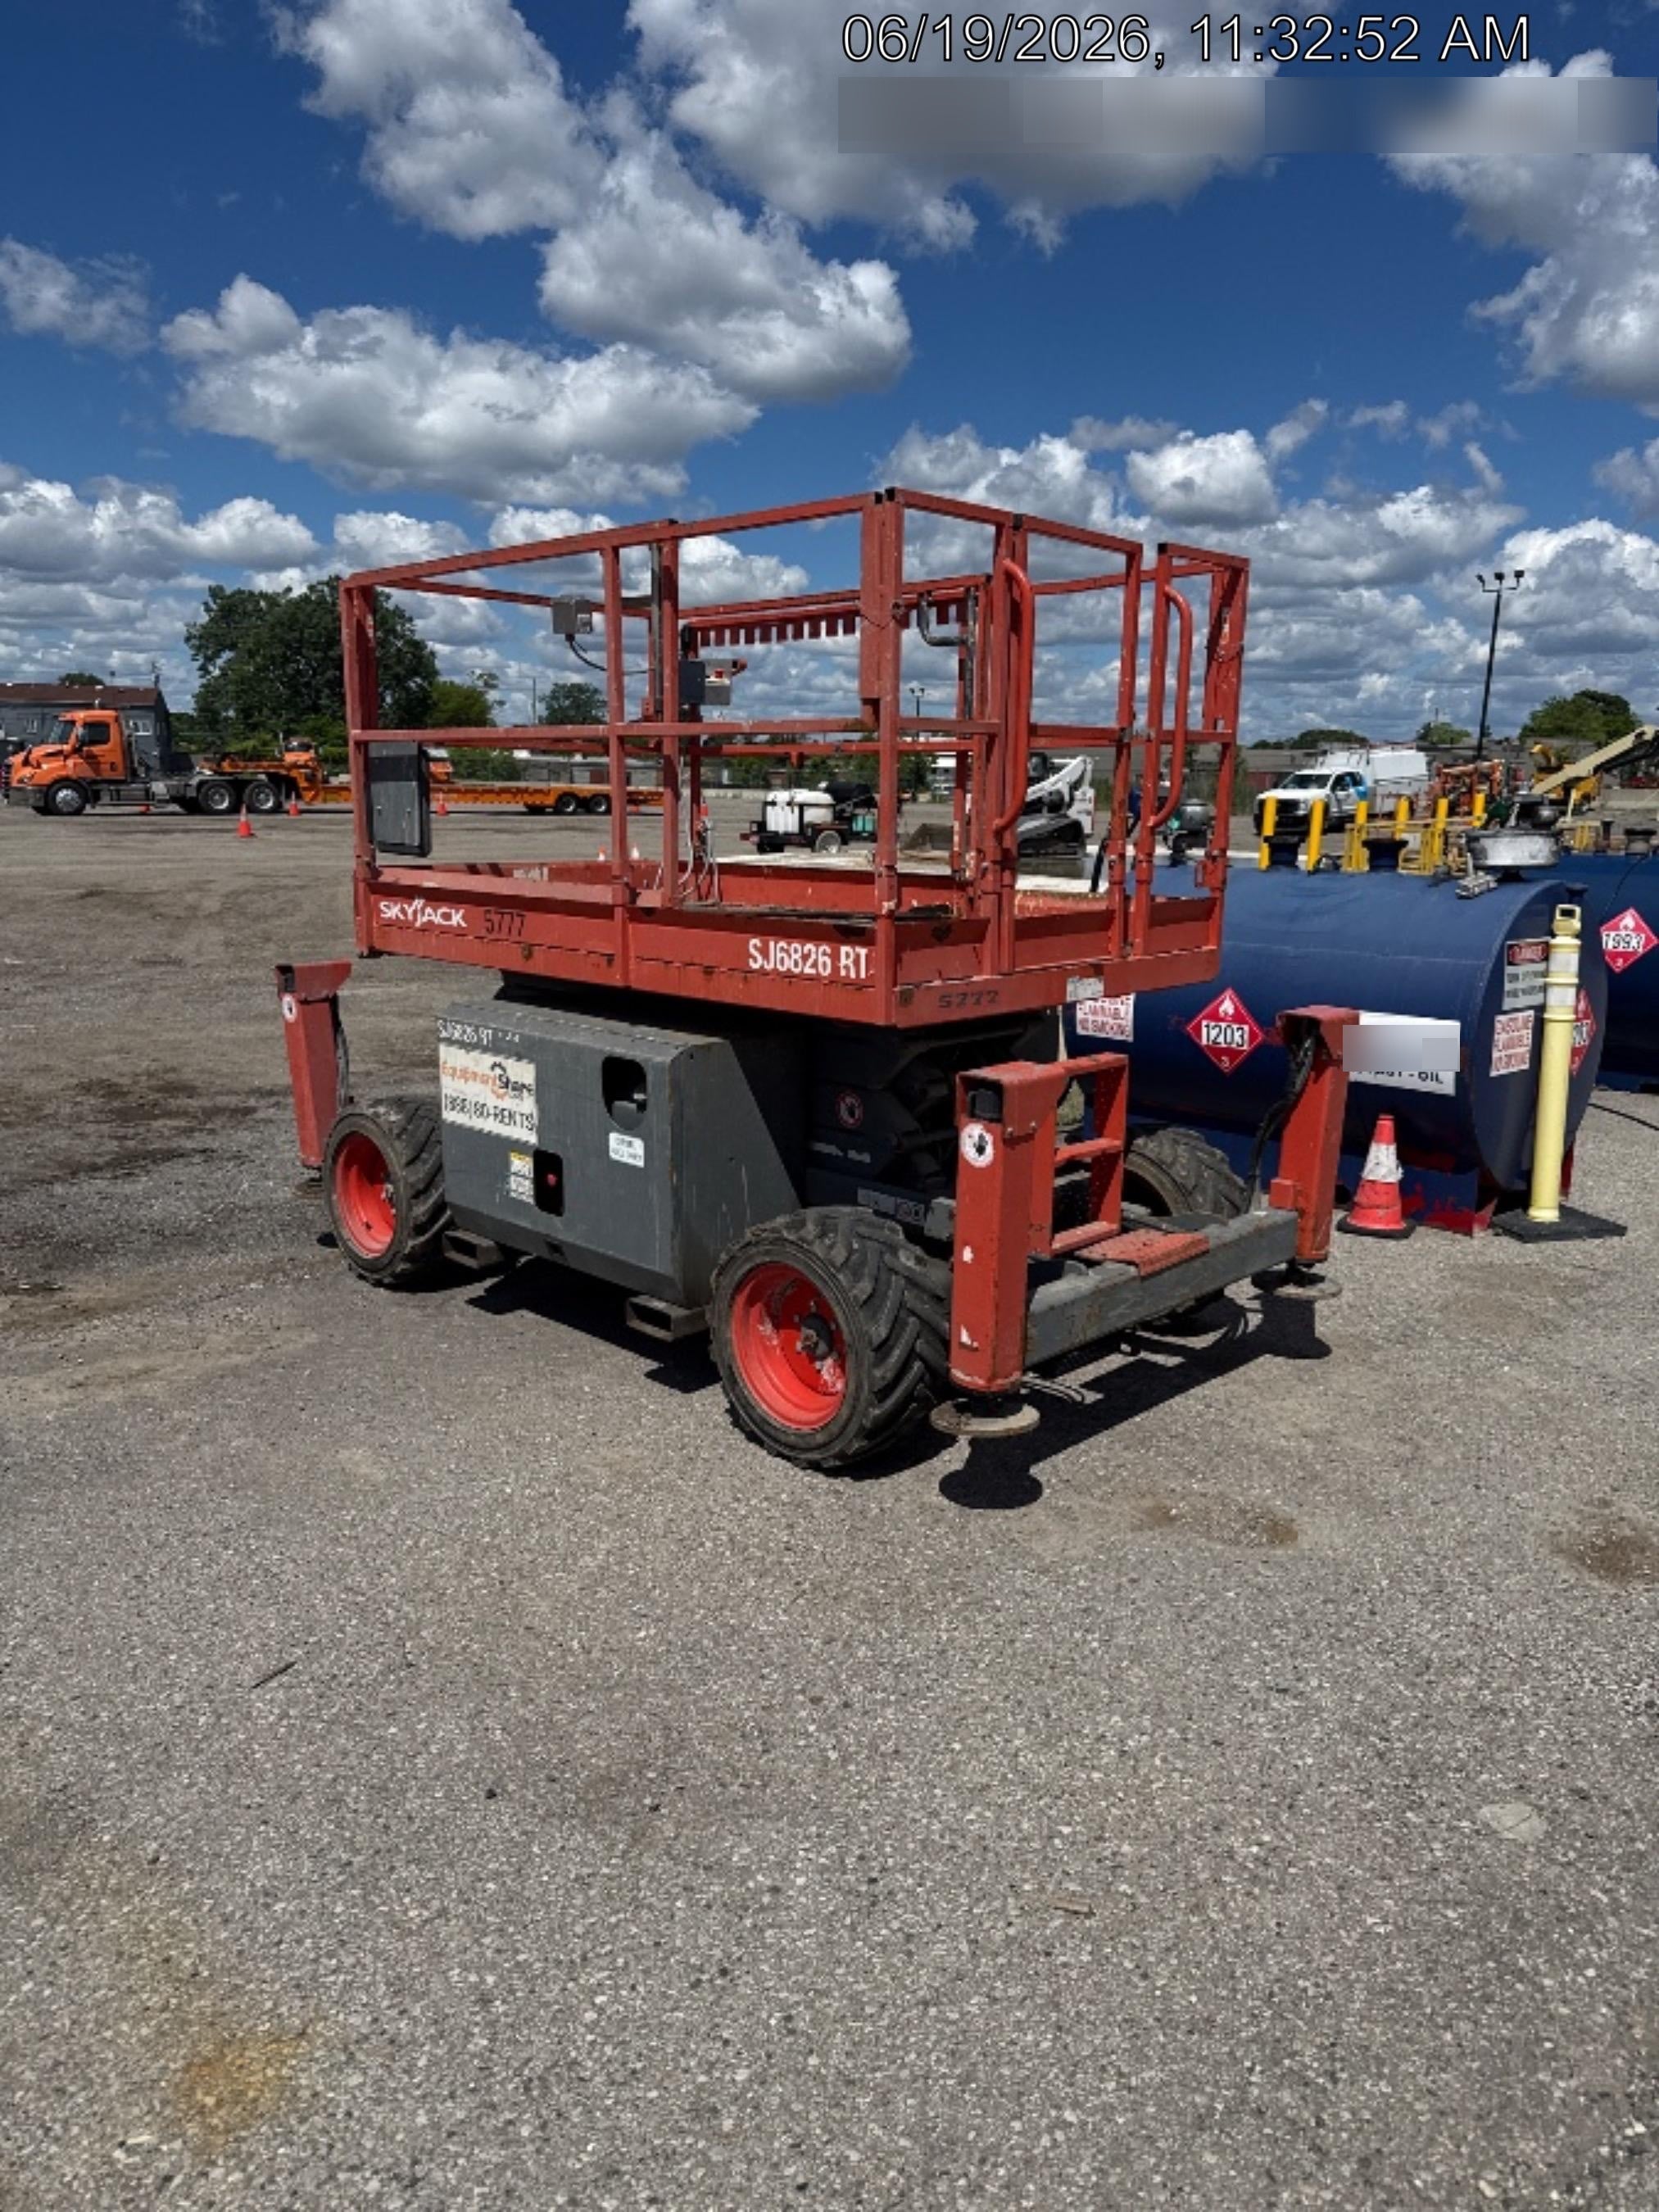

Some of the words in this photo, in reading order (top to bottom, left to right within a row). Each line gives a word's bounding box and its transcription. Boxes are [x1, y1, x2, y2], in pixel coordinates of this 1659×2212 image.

[379, 898, 467, 927] SKYJACK
[483, 908, 527, 937] 5777
[748, 938, 832, 977] SJ6826
[838, 945, 868, 979] RT
[1204, 1022, 1245, 1047] 1203
[1221, 1056, 1231, 1072] 3
